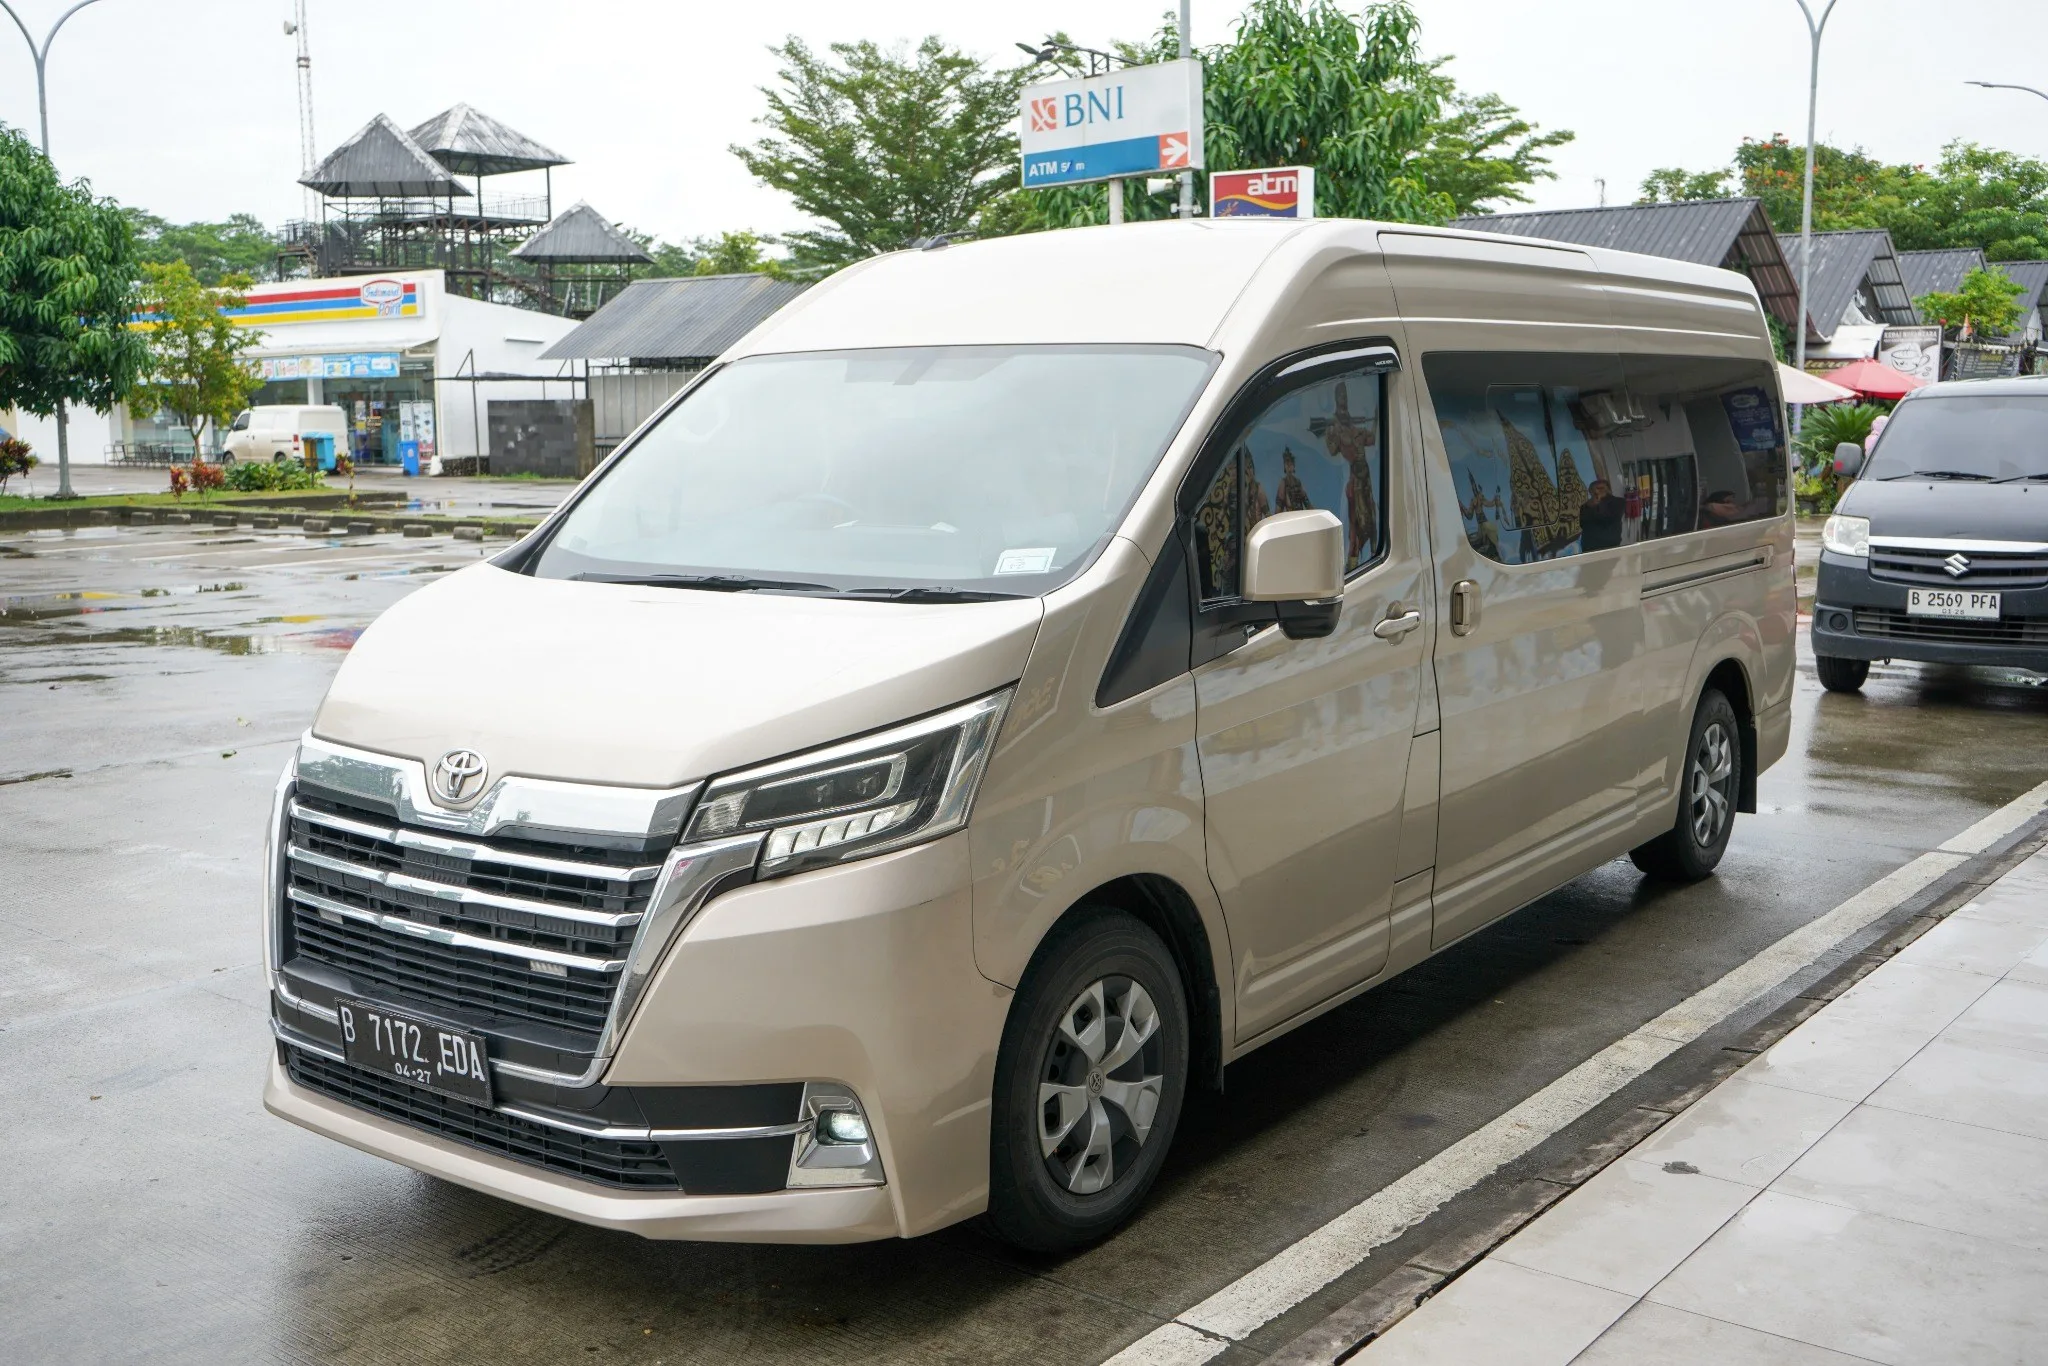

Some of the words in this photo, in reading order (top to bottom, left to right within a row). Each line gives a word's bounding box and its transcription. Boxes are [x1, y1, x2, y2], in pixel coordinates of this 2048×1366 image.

[1065, 85, 1123, 127] BNI
[1028, 161, 1057, 177] ATM
[1075, 162, 1085, 171] m
[1247, 173, 1298, 196] atm
[1912, 591, 1920, 605] B
[1928, 592, 1963, 607] 2569
[1971, 594, 1997, 609] PFA
[340, 1006, 356, 1043] B
[368, 1013, 425, 1063] 7172
[438, 1032, 486, 1082] EDA
